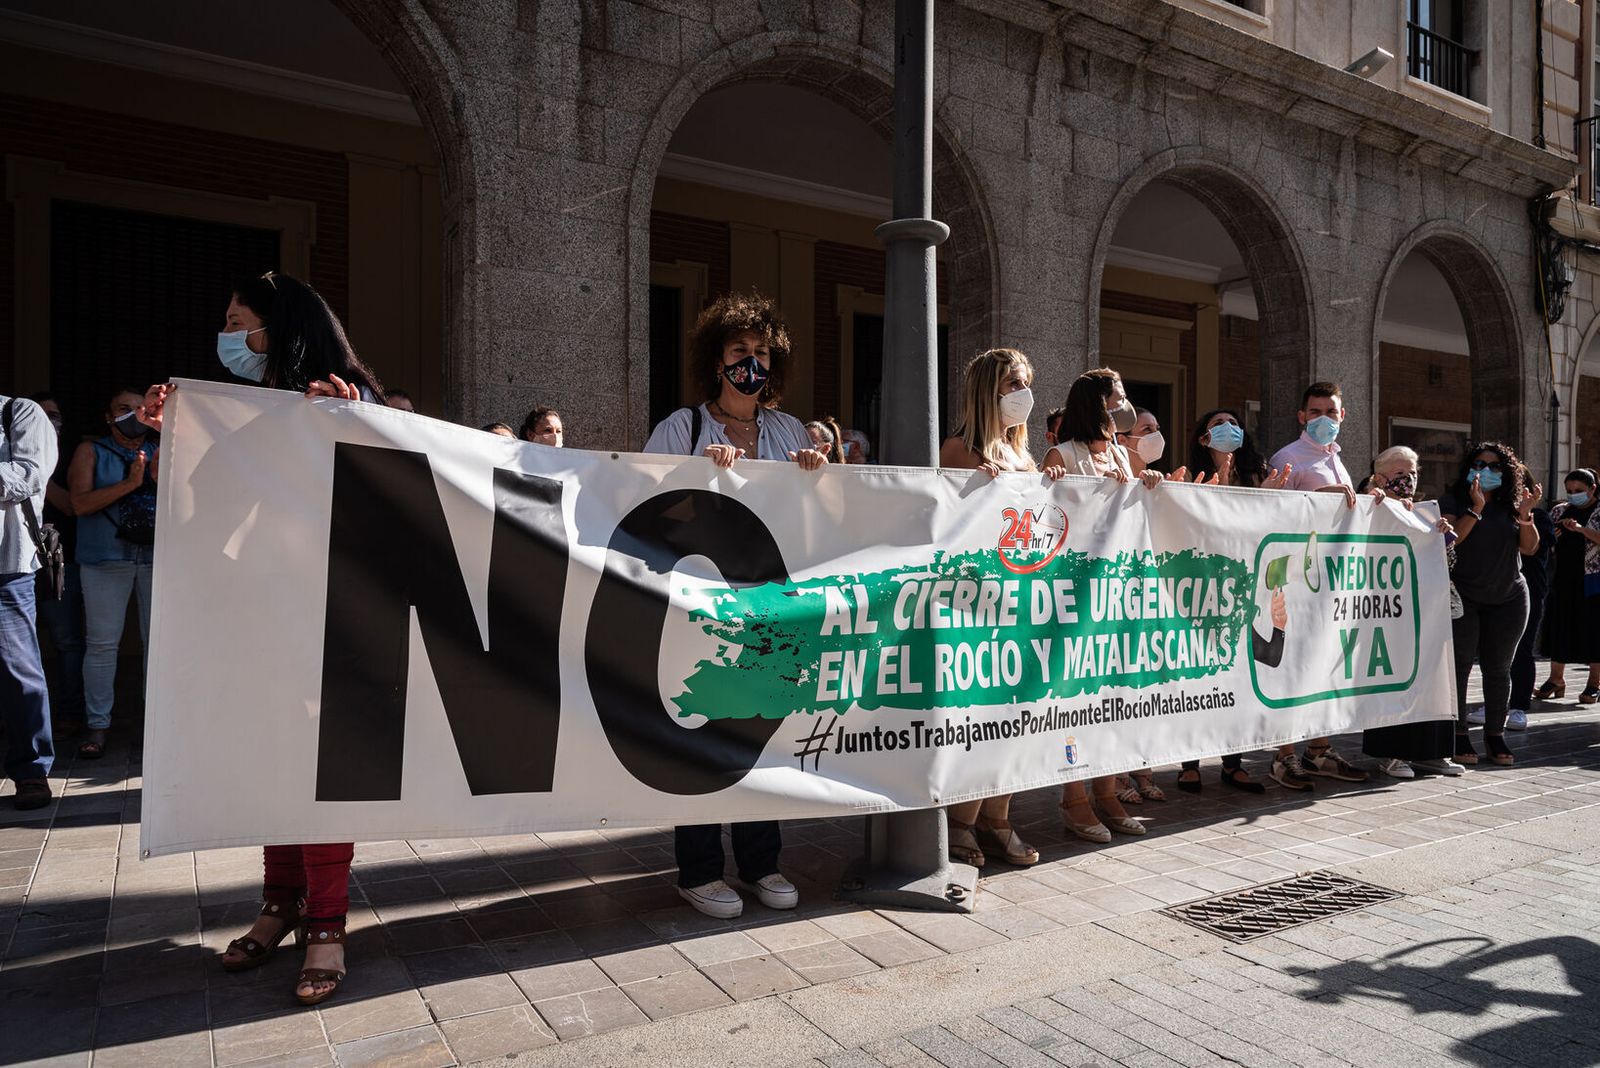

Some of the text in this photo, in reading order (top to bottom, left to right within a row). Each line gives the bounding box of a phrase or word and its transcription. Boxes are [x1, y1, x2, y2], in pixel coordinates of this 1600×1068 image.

[1325, 546, 1405, 592] MÉDICO
[820, 576, 1236, 636] AL CIERRE DE URGENCIAS
[1333, 594, 1403, 622] 24 HORAS
[816, 619, 1232, 702] EN EL ROCÍO Y MATALASCAÑAS
